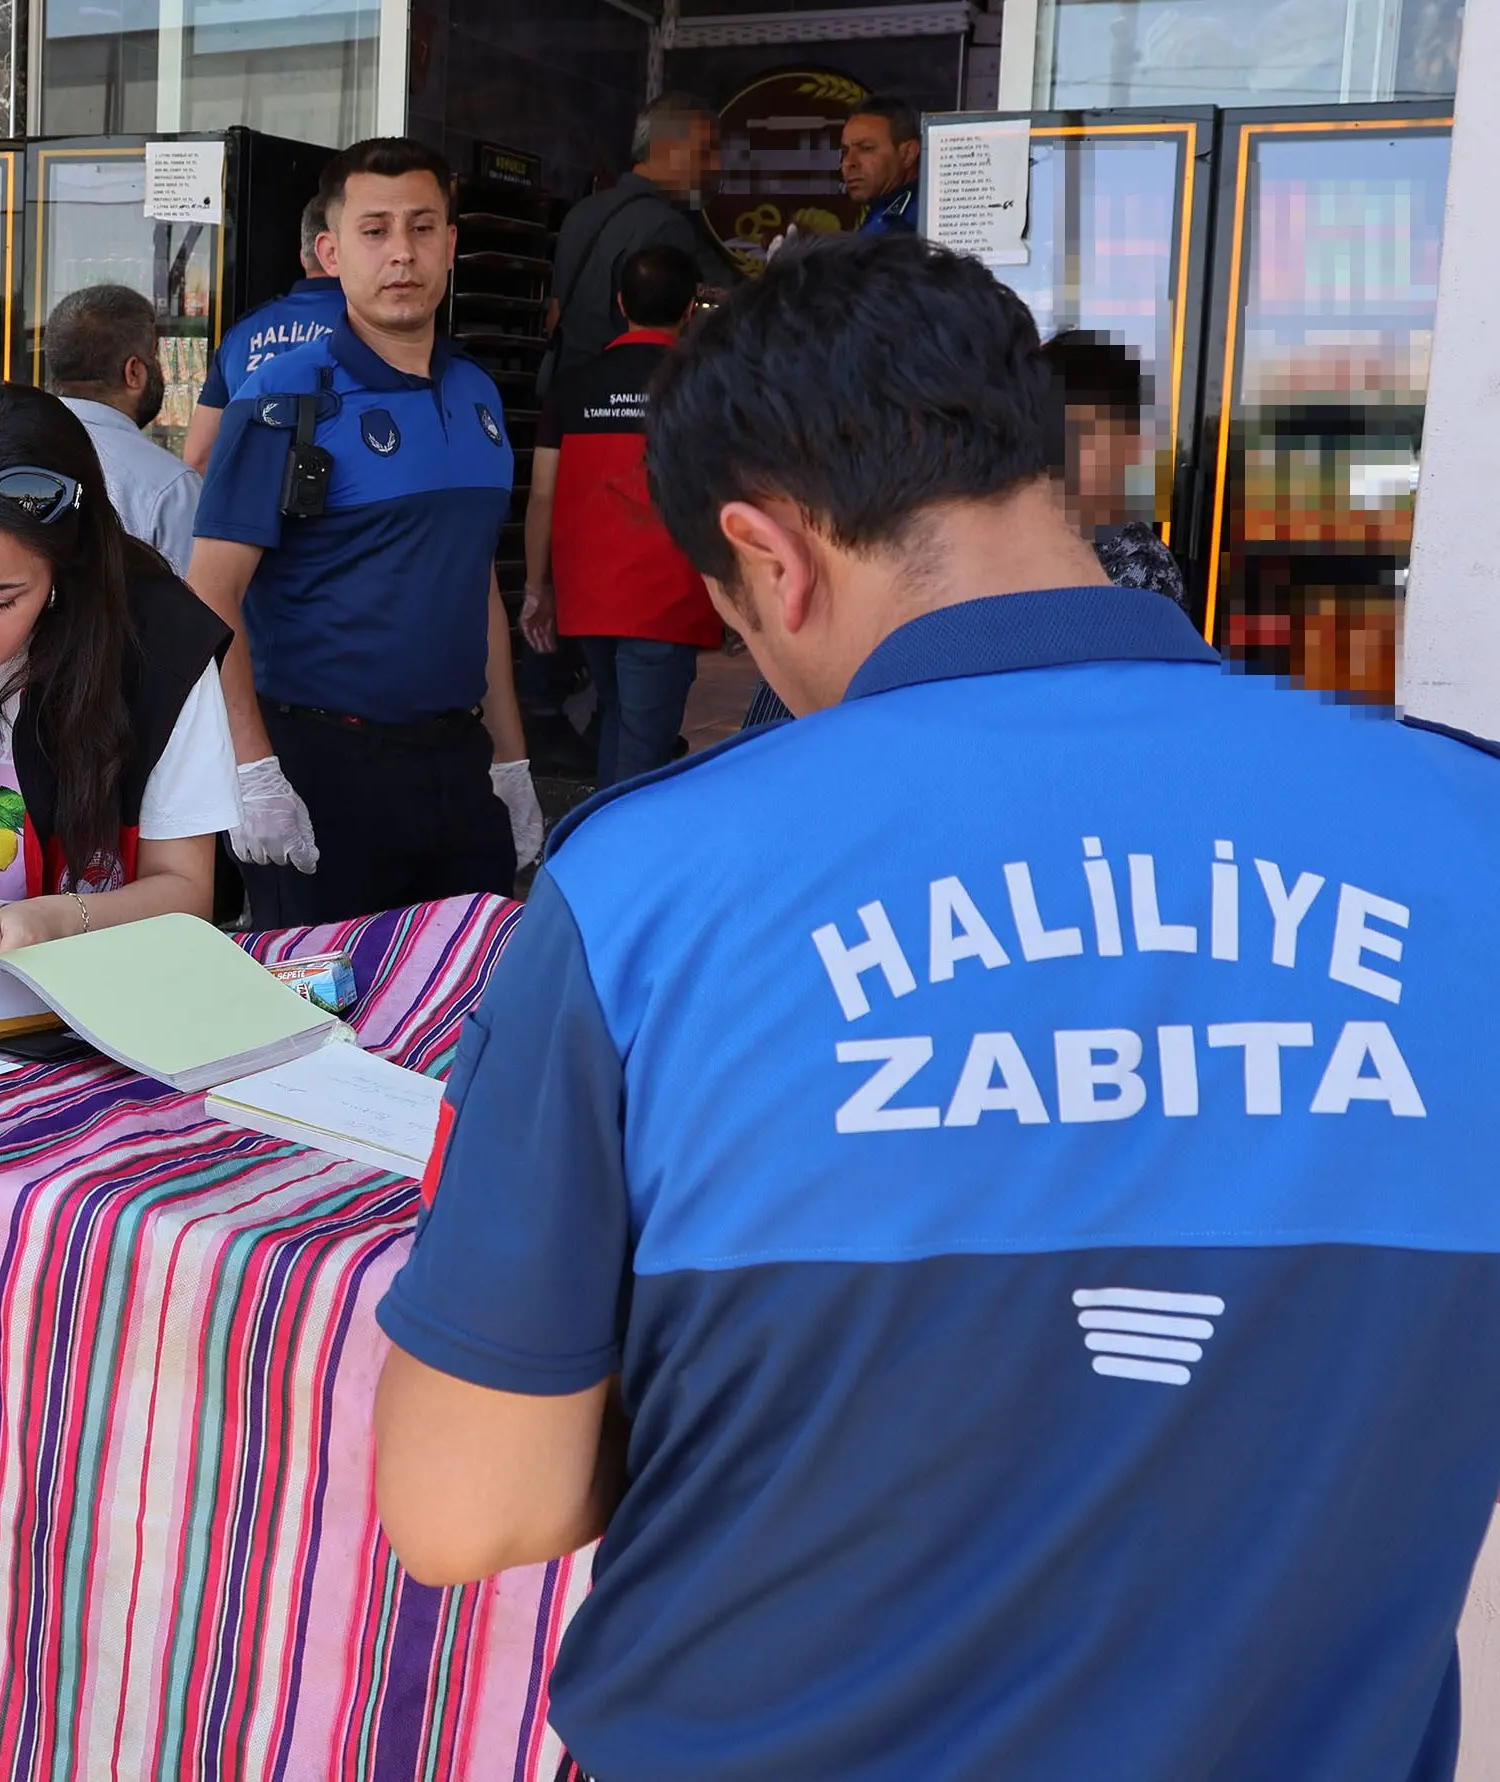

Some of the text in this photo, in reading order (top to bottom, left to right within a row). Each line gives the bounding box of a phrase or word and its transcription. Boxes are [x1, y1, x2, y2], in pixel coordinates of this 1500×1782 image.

[277, 970, 306, 980] SEPETE
[811, 836, 1410, 1022] HALİLİYE
[835, 1021, 1427, 1134] ZABITA
